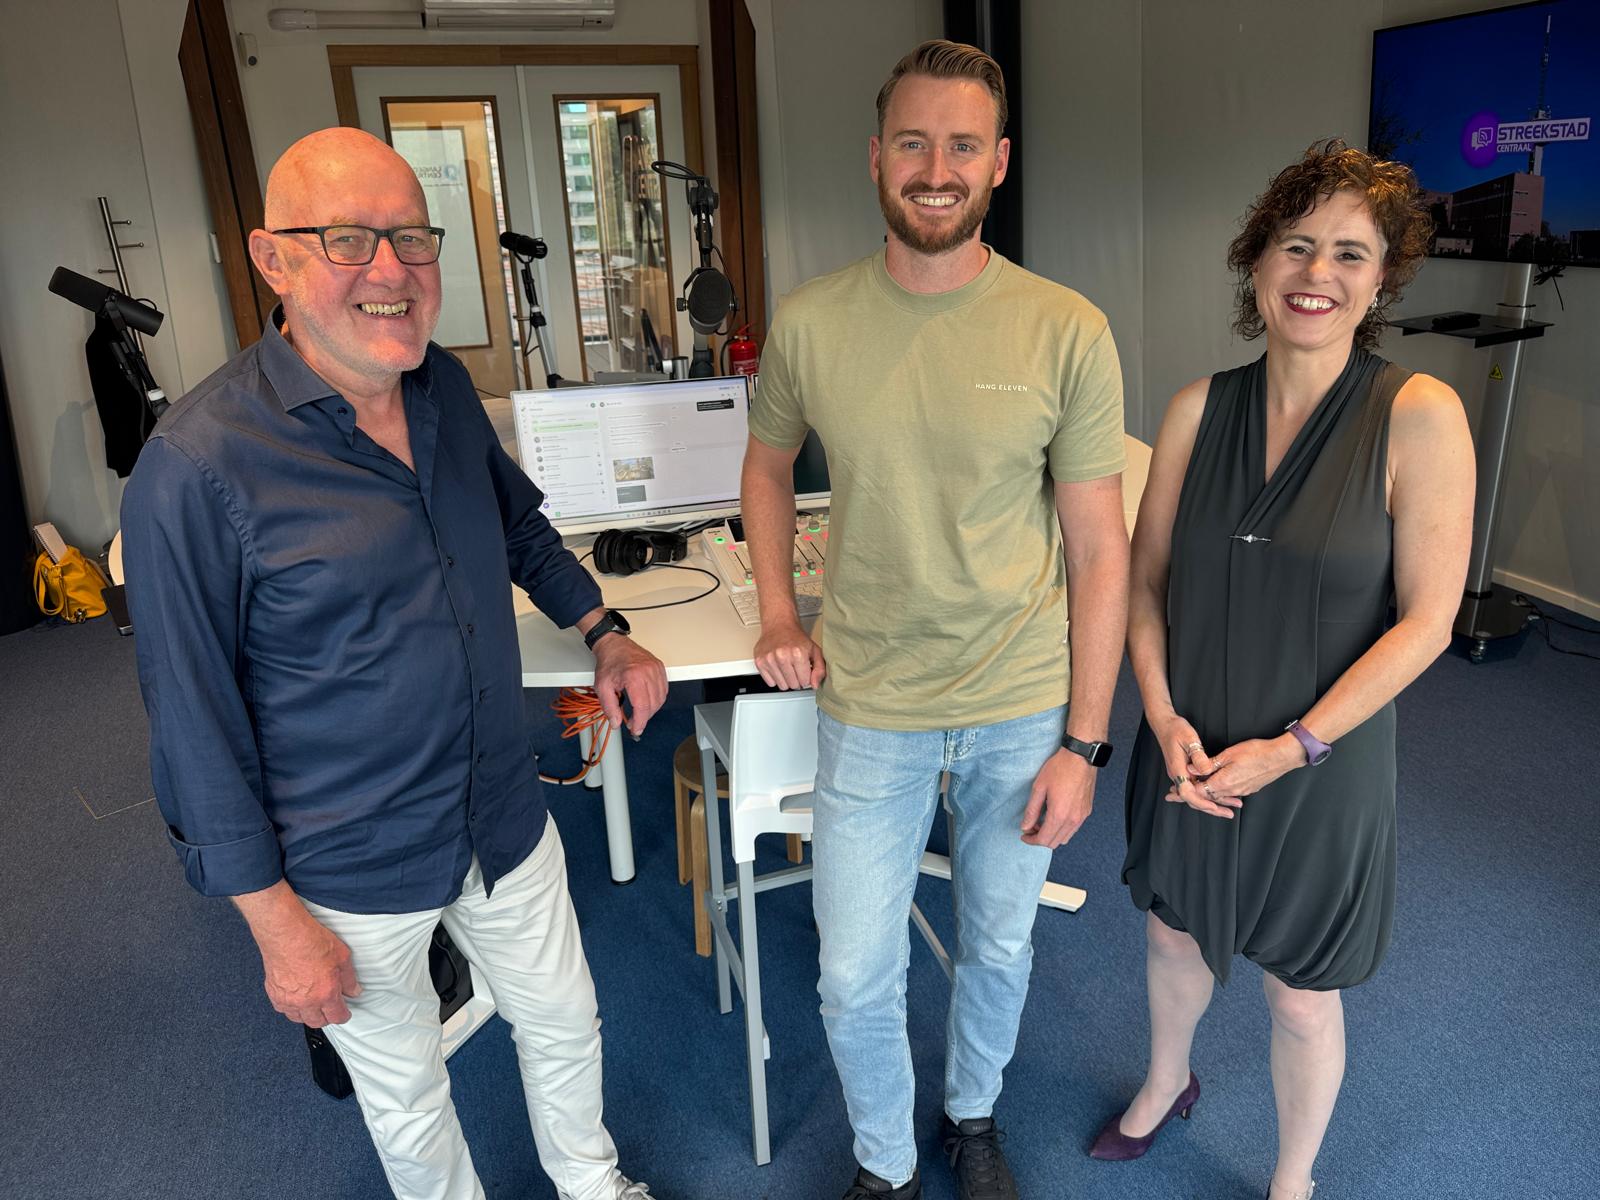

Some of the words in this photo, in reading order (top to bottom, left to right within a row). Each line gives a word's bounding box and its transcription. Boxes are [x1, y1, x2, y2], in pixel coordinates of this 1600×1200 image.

[1498, 122, 1588, 141] STREEKSTAD
[1497, 143, 1532, 152] CENTRAAL
[998, 384, 1028, 392] ELEVEN
